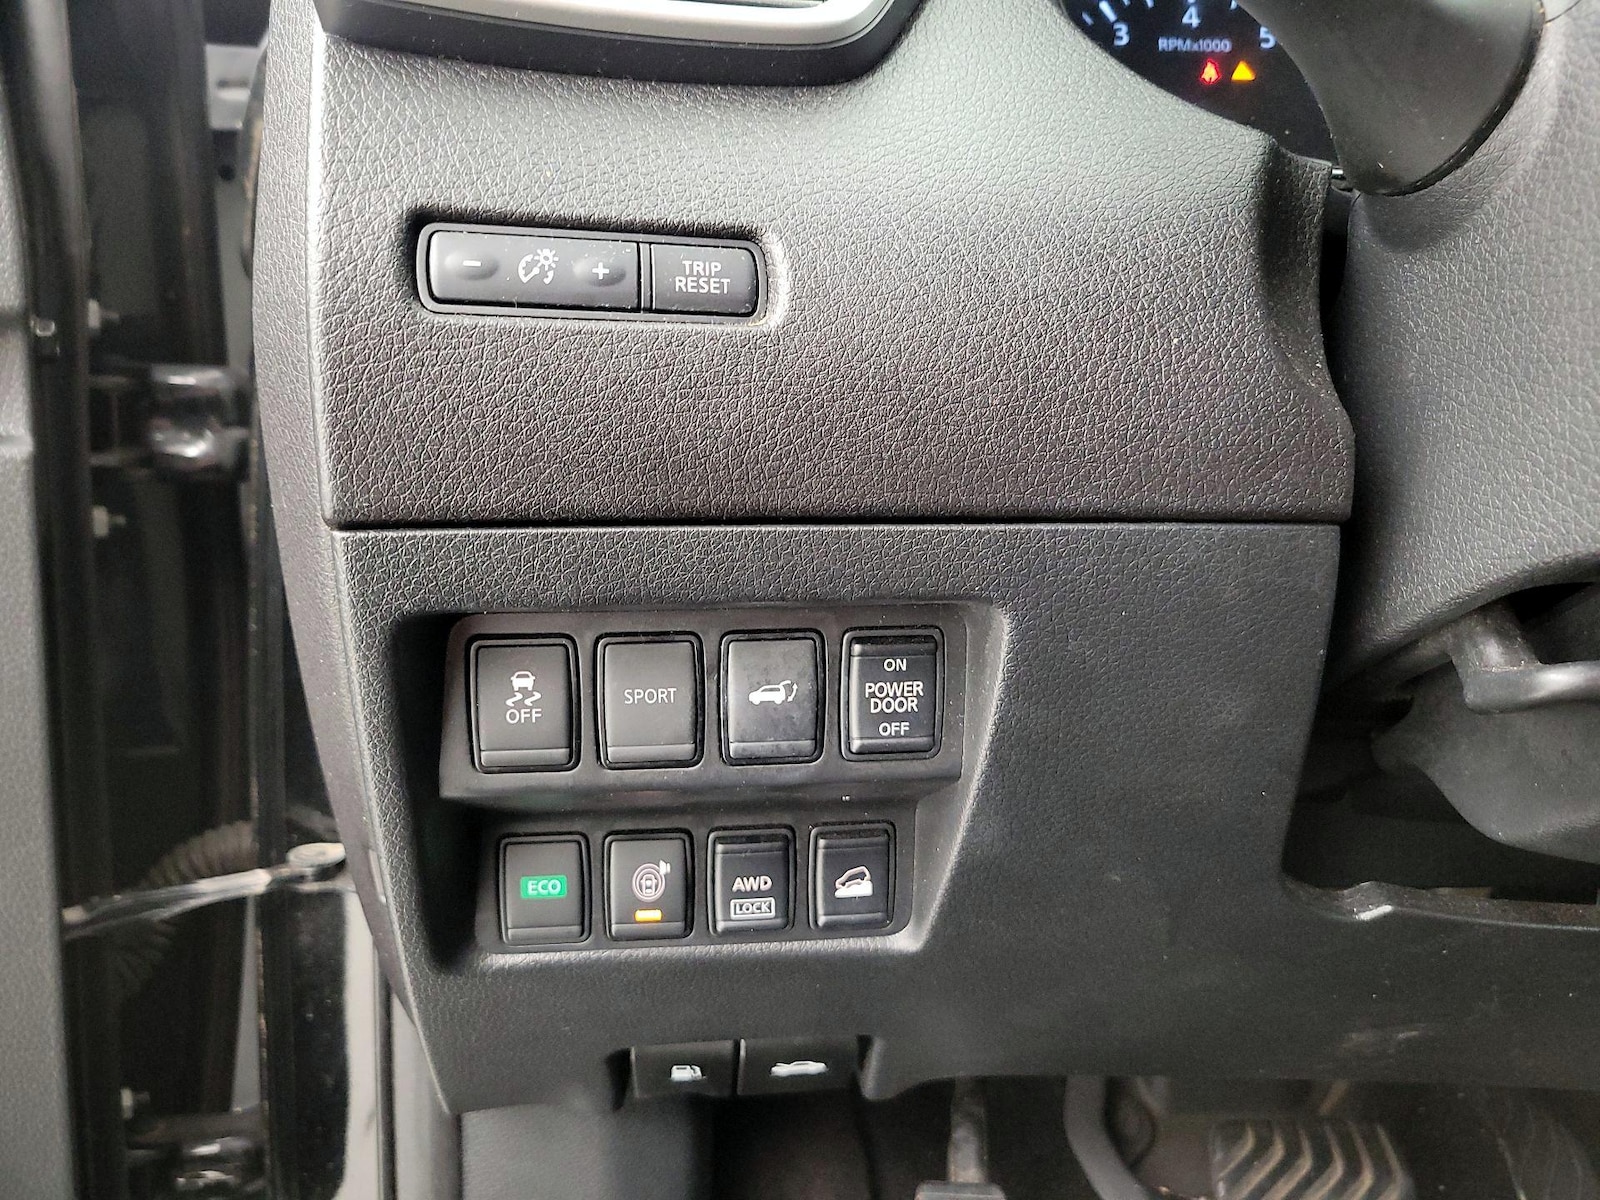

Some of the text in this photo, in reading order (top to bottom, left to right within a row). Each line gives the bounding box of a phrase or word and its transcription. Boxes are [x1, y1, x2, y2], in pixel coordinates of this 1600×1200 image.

[1181, 5, 1201, 28] 4
[1112, 22, 1131, 46] 3
[1259, 26, 1276, 49] 5
[682, 259, 722, 277] TRIP
[674, 276, 731, 295] RESET
[883, 658, 907, 672] ON
[623, 687, 678, 705] SPORT
[865, 681, 924, 698] POWER
[870, 697, 918, 714] DOOR
[505, 707, 542, 724] OFF
[878, 721, 910, 737] OFF
[526, 878, 562, 896] ECO
[731, 875, 773, 893] AWD
[735, 902, 771, 915] LOCK
